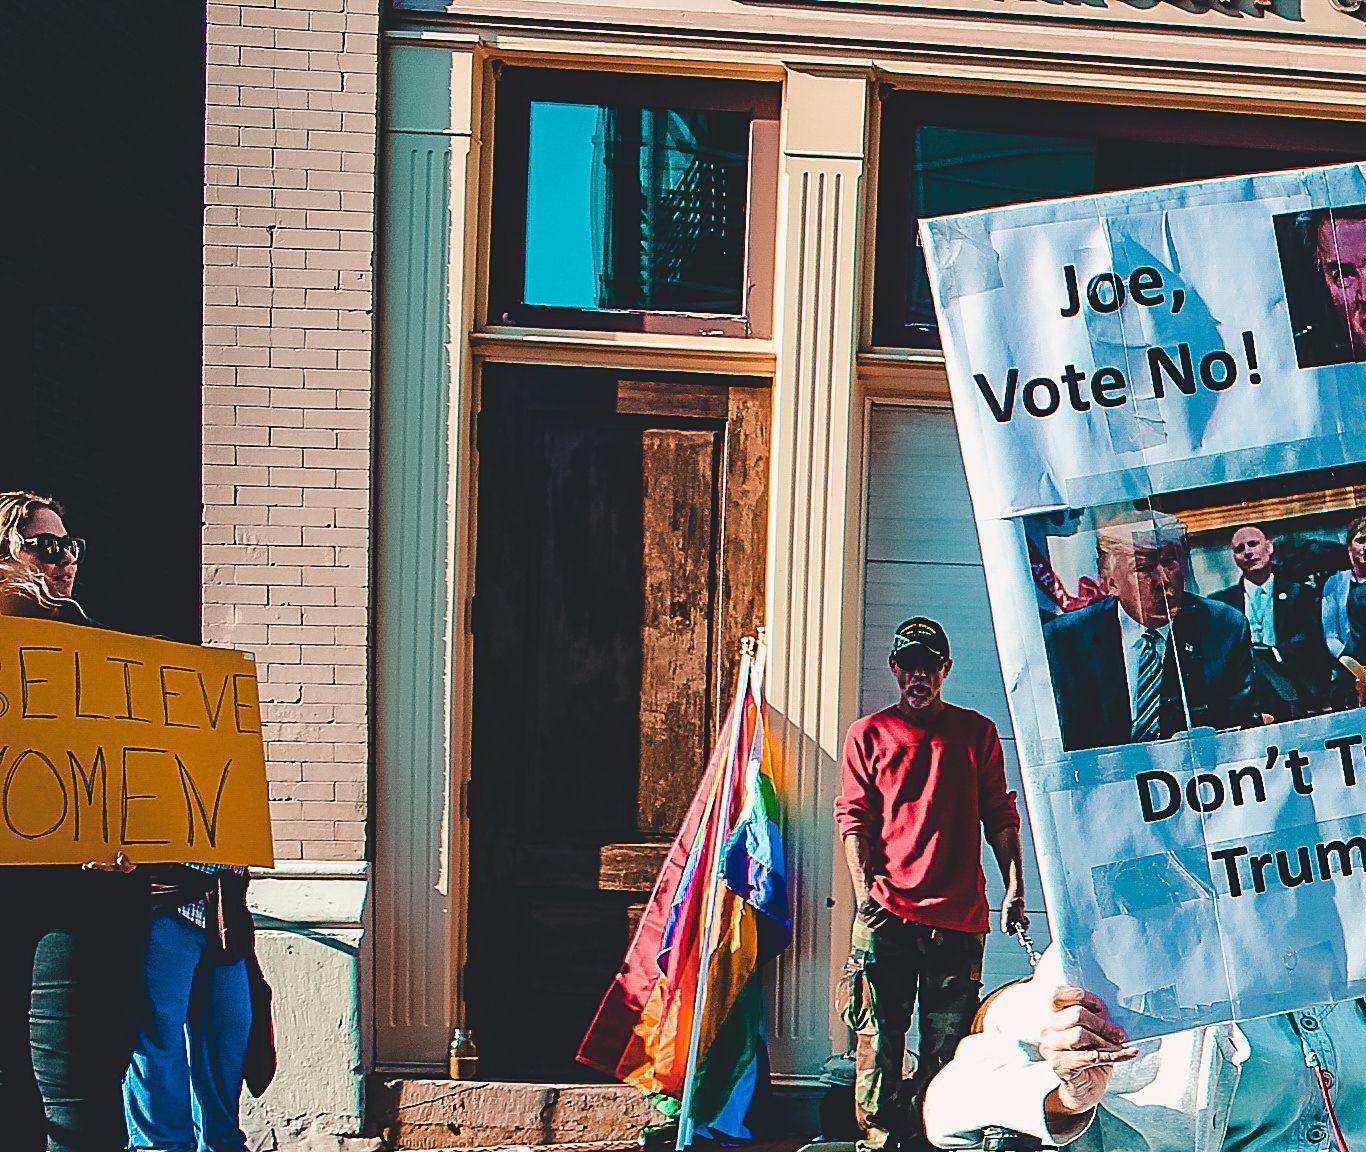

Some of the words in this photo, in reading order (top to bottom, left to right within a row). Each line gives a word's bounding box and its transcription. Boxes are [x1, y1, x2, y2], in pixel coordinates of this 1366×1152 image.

[1060, 264, 1186, 318] Joe,
[973, 364, 1127, 423] Vote
[1147, 330, 1262, 399] No!
[0, 646, 261, 734] ELIEVE
[0, 745, 233, 848] OMEN
[1136, 746, 1314, 823] Don't
